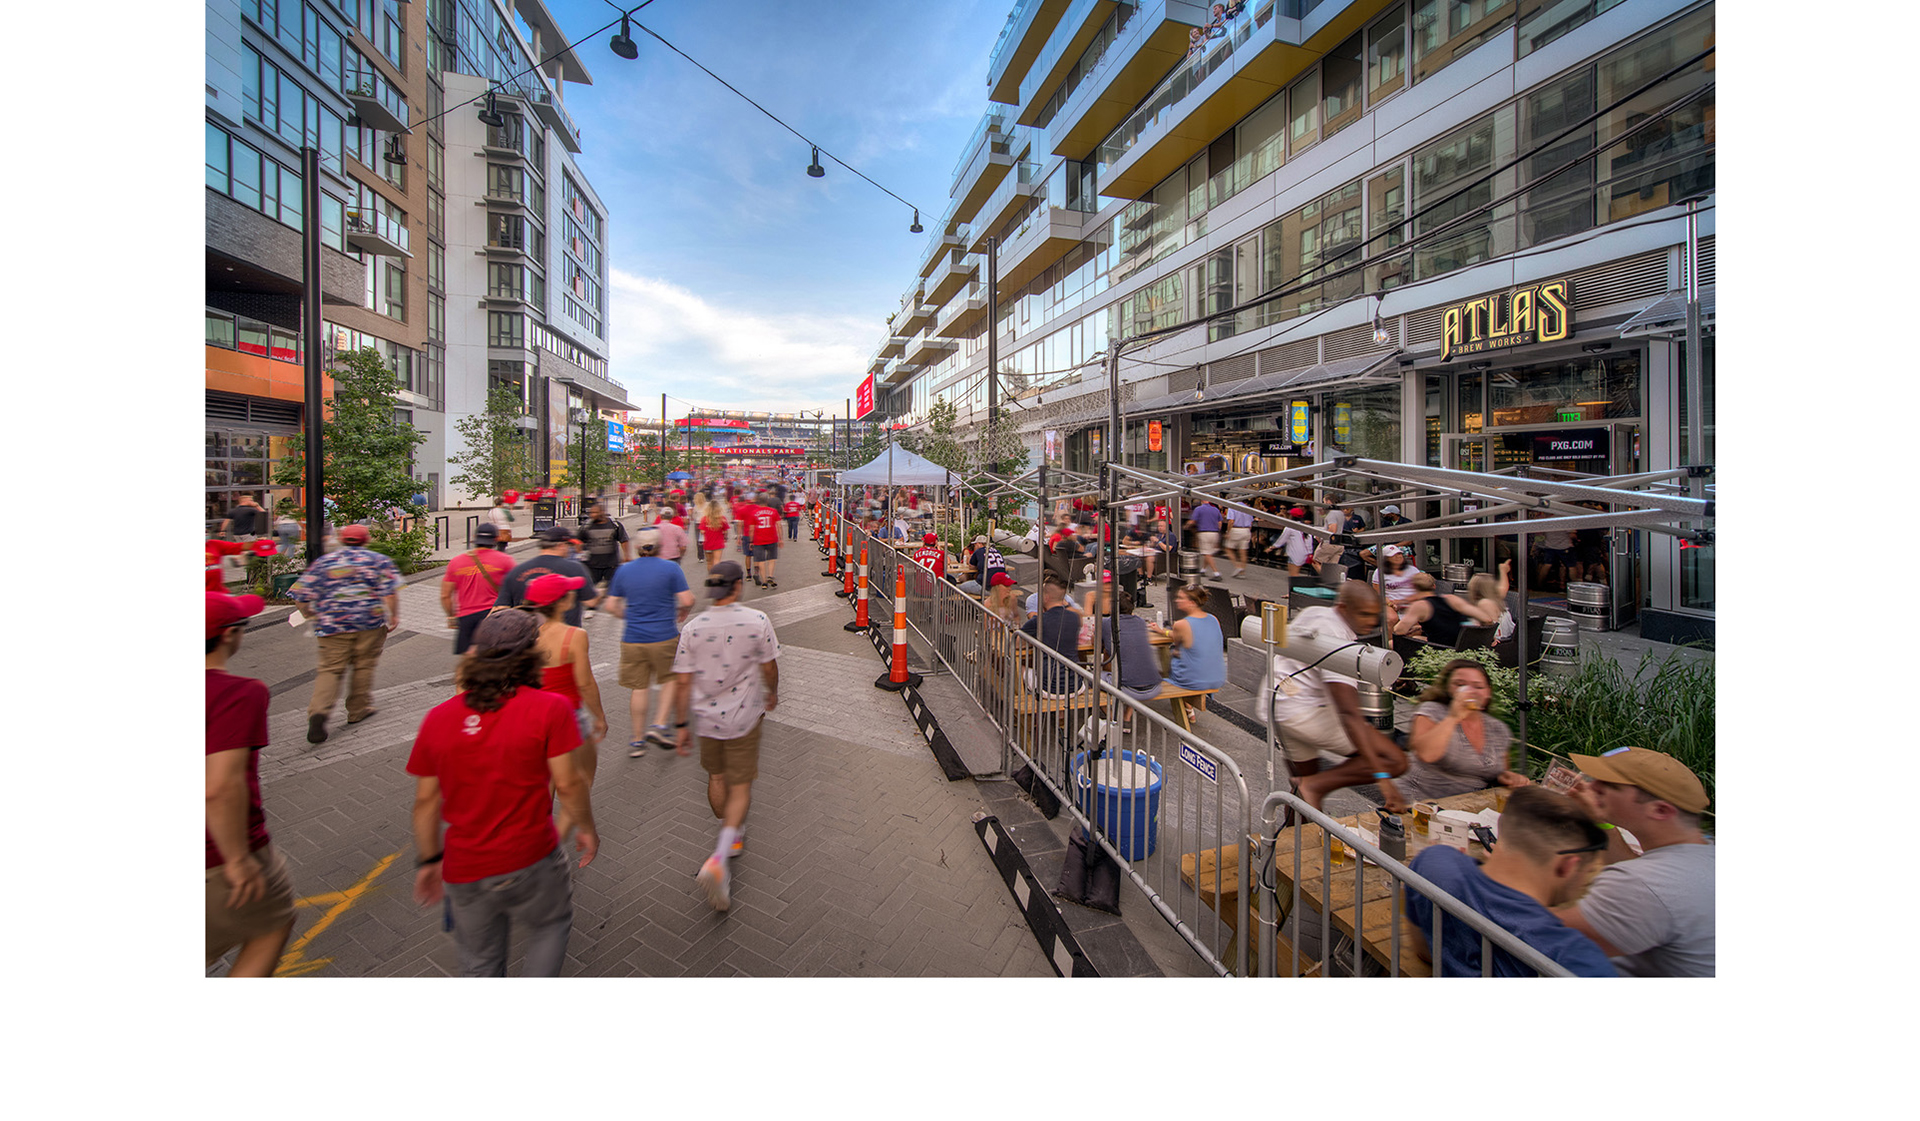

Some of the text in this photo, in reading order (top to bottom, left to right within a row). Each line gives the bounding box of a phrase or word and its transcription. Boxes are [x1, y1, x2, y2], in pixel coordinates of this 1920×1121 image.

[1440, 279, 1567, 361] ATLAS
[1458, 335, 1522, 353] BREW WORKS
[1550, 440, 1593, 450] PXG.COM
[758, 516, 771, 528] 31
[915, 550, 941, 559] KENDRICK
[987, 552, 1005, 569] 22
[918, 557, 936, 572] 47
[1181, 744, 1215, 778] LONG FENCE
